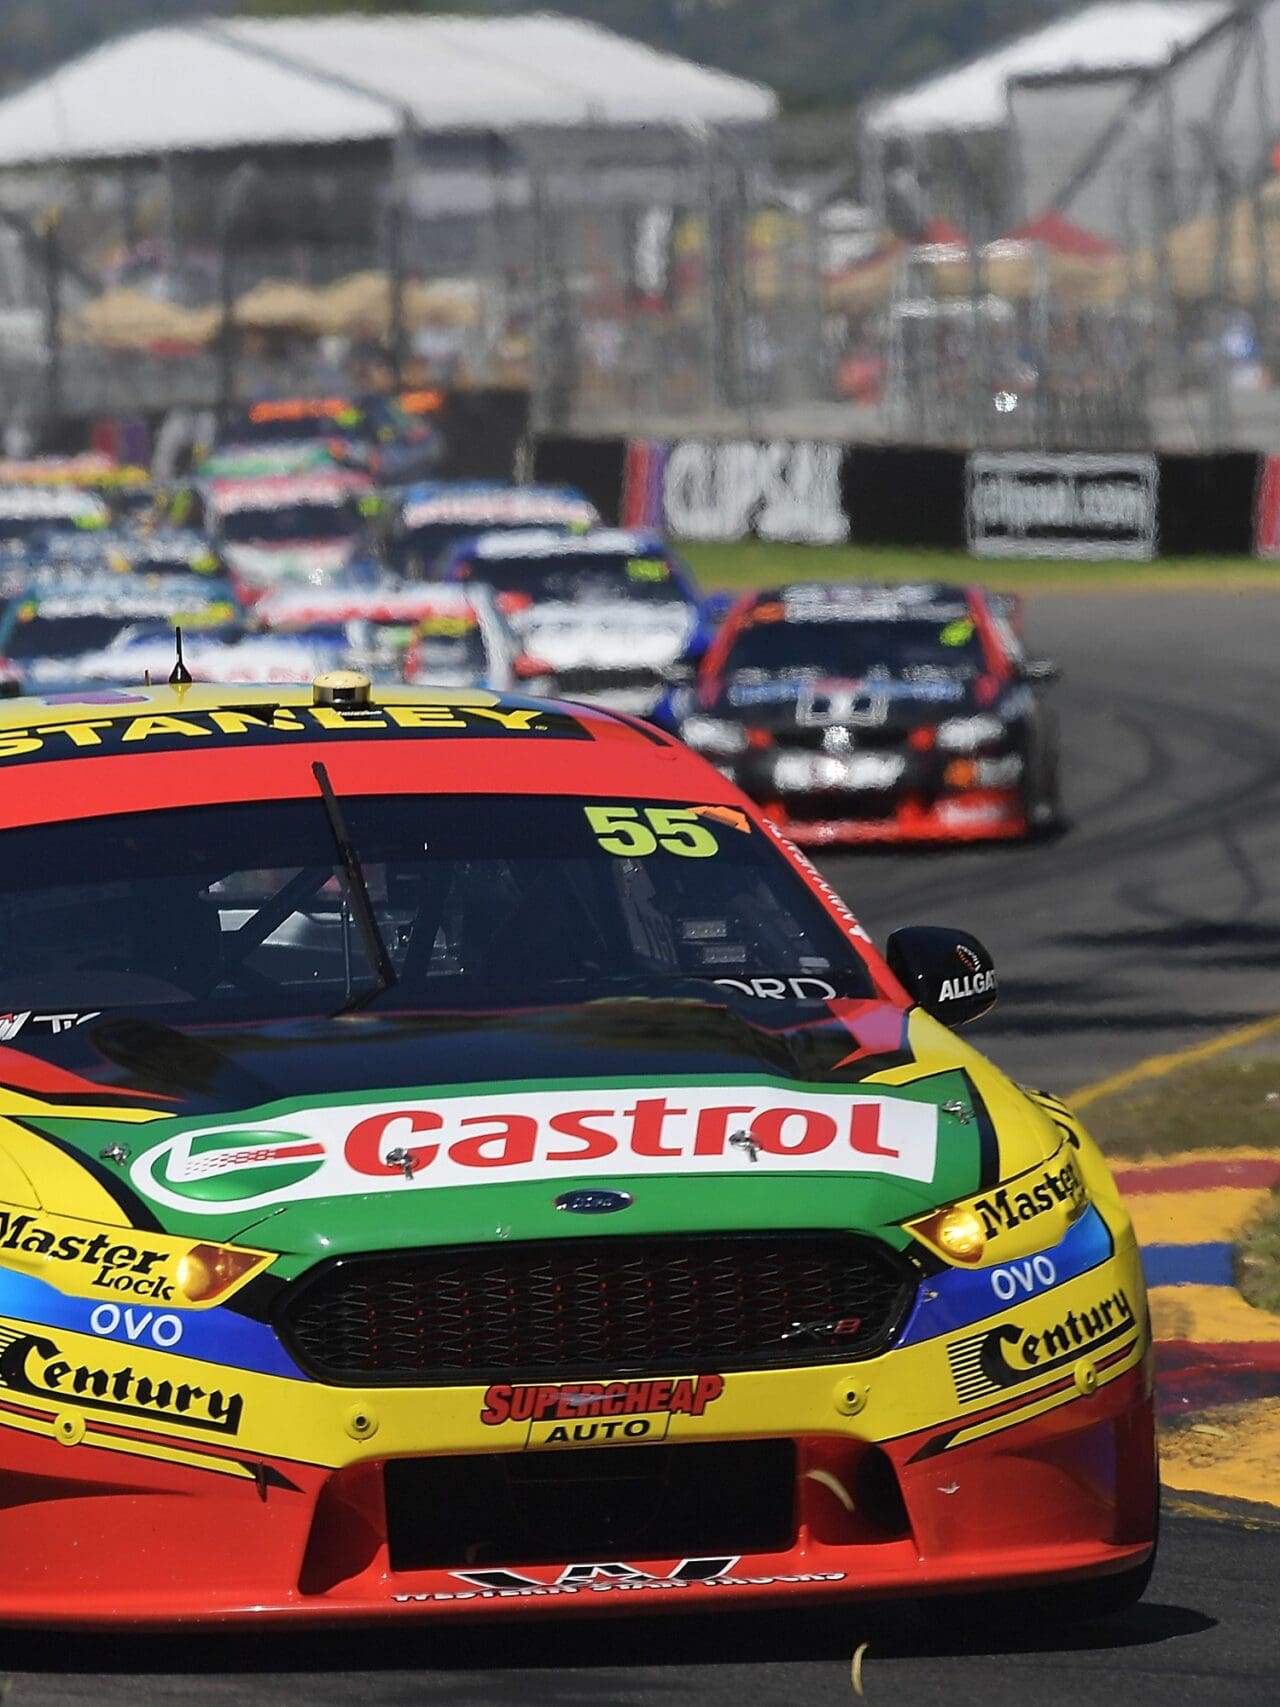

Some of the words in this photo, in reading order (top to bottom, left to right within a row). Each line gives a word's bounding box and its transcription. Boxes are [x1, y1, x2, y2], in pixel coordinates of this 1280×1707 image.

[584, 806, 719, 858] 55
[344, 1097, 901, 1177] Castrol
[91, 1264, 176, 1302] Lock
[991, 1255, 1057, 1301] OVO
[90, 1303, 184, 1347] OVO
[978, 1288, 1137, 1388] Century
[480, 1373, 725, 1426] SUPERCHEAP
[544, 1419, 651, 1444] AUTO
